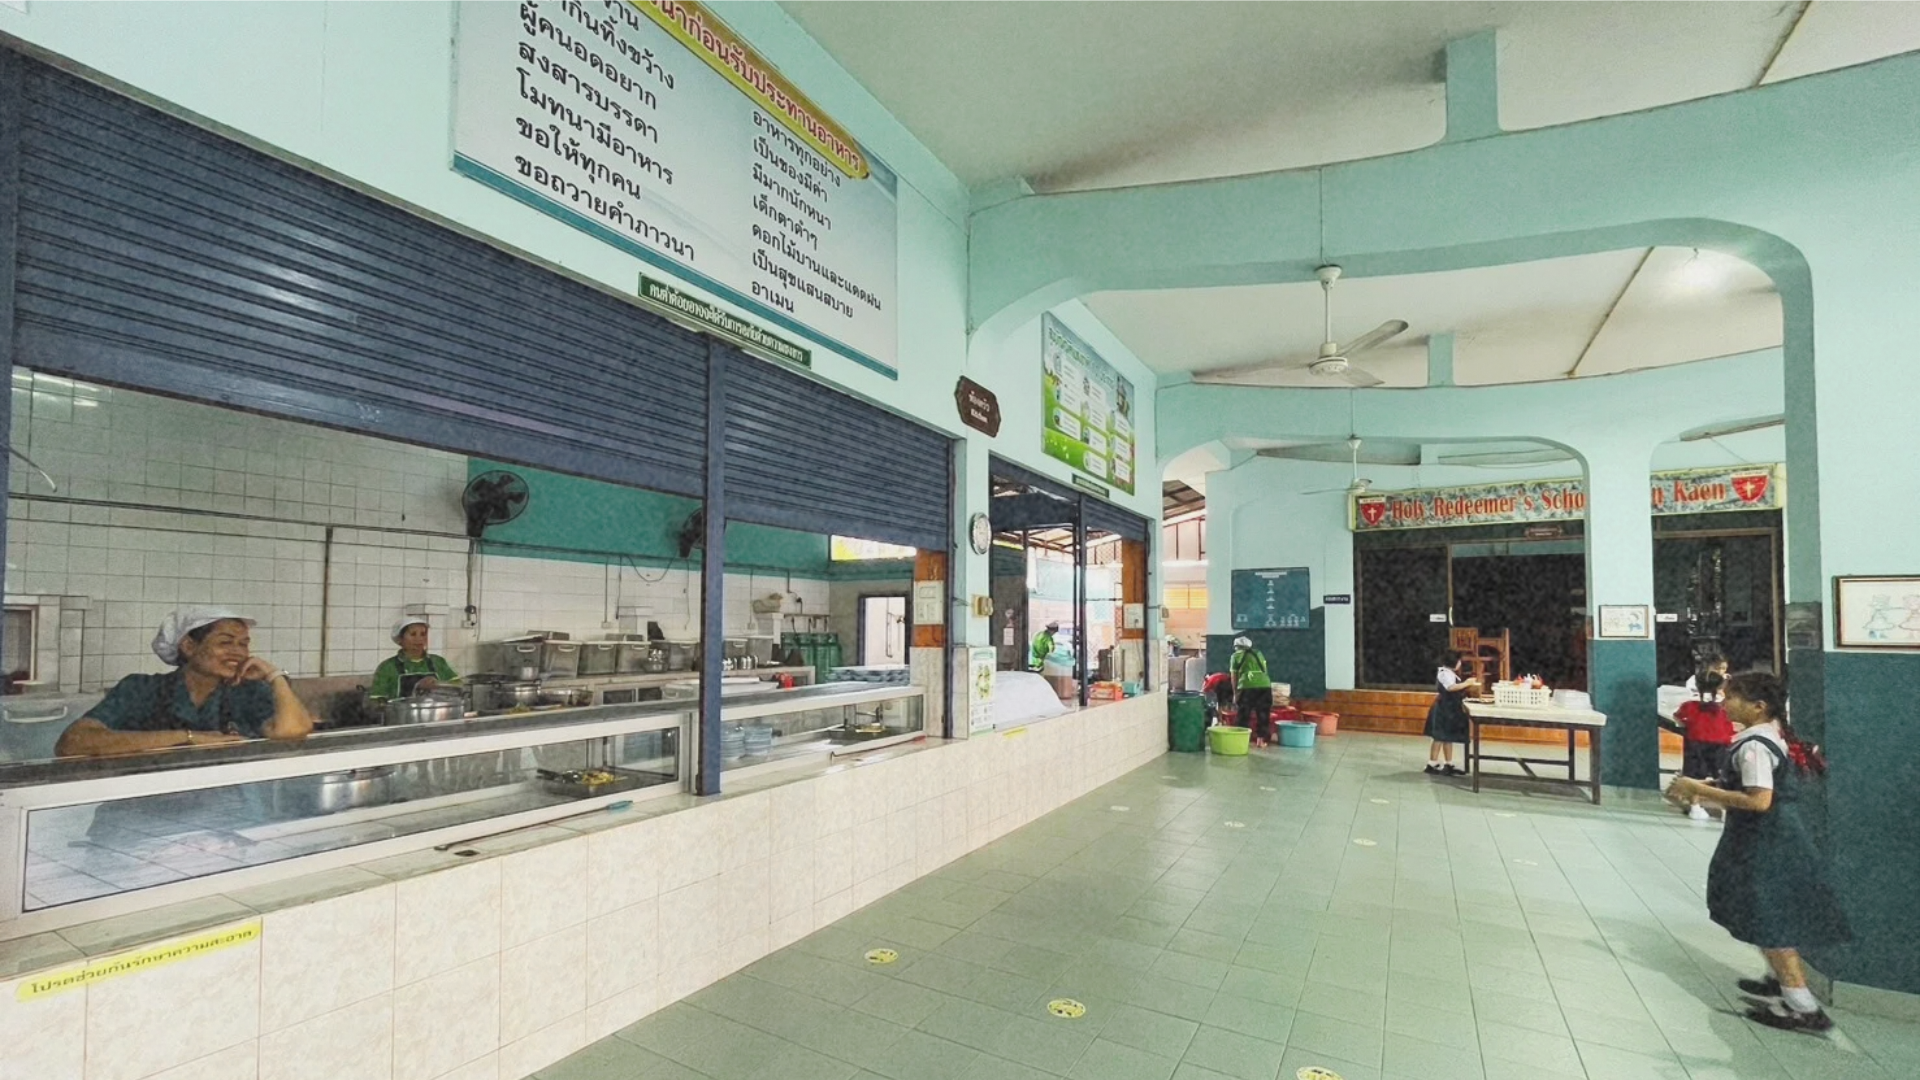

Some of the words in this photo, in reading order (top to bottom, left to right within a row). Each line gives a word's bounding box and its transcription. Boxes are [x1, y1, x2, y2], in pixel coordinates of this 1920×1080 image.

[518, 42, 658, 144] สงสารบรรดา
[519, 0, 657, 110] ผู้คนอดอยาก
[651, 0, 860, 171] นาก่อนรับประทานอาหาร
[516, 67, 674, 185] โมทนามีอาหาร
[516, 117, 641, 200] ขอให้ทุกคน
[752, 111, 841, 187] อาหารทุกอย่าง
[752, 162, 832, 231] มีมากนักหนา
[753, 136, 828, 203] เป็นของมีค่า
[515, 155, 695, 262] ขอถวายคำภาวนา
[753, 193, 818, 251] เด็กตาดำๆ
[751, 280, 795, 313] อาเมน
[752, 248, 854, 318] เป็นสุขแสนสบาย
[1433, 489, 1534, 518] Redeemer's
[1673, 480, 1727, 503] Kaen
